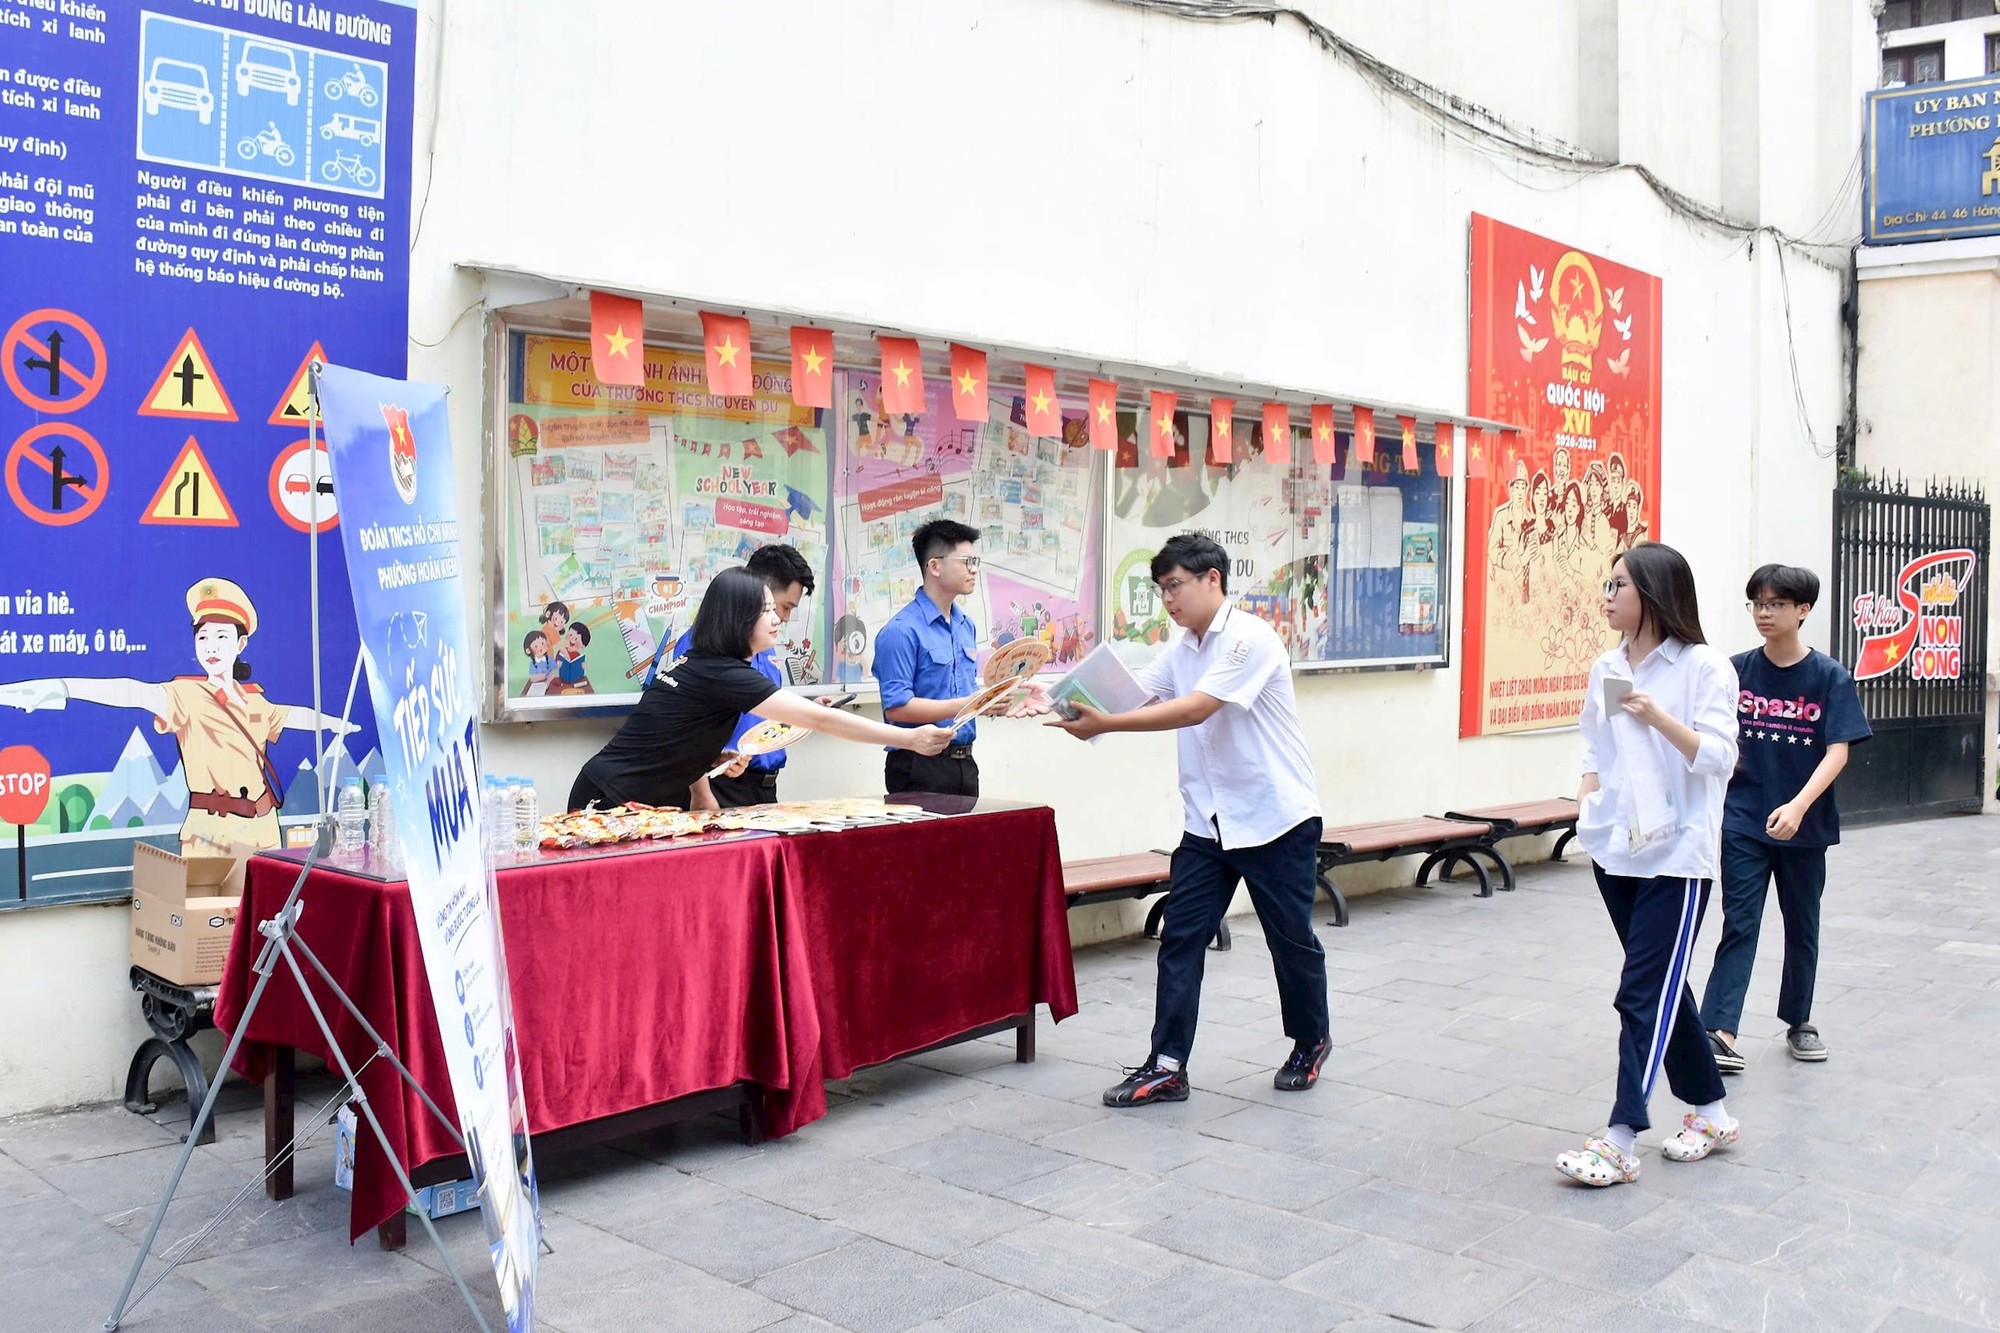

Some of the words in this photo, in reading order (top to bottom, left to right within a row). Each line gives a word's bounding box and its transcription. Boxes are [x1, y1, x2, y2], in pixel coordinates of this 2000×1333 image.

[42, 18, 58, 34] xi
[69, 21, 106, 44] lanh
[297, 2, 331, 32] LÀN
[335, 13, 392, 46] ĐƯỜNG
[14, 68, 60, 92] được
[63, 77, 101, 99] điều
[1, 89, 35, 109] tích
[42, 96, 58, 113] xi
[64, 98, 101, 121] lanh
[1946, 91, 1988, 111] BAN
[1909, 115, 1991, 138] PHƯỜNG
[22, 136, 67, 161] định)
[0, 171, 28, 191] hải
[33, 176, 62, 198] đội
[67, 183, 95, 200] mũ
[137, 170, 187, 190] Người
[196, 179, 232, 198] điều
[242, 186, 284, 206] khiển
[293, 196, 348, 219] phương
[357, 205, 385, 222] tiện
[44, 200, 94, 225] thông
[137, 193, 171, 210] phải
[180, 199, 196, 214] đi
[206, 202, 234, 219] bên
[243, 209, 275, 226] phải
[283, 214, 316, 232] theo
[324, 221, 362, 238] chiều
[370, 227, 385, 242] đi
[1931, 209, 1947, 220] 44
[1952, 207, 1968, 219] 46
[21, 220, 59, 239] toàn
[63, 224, 94, 243] của
[136, 214, 165, 232] của
[169, 220, 208, 237] mình
[212, 225, 228, 240] đi
[232, 227, 271, 249] đúng
[275, 233, 297, 250] làn
[301, 237, 347, 260] đường
[350, 245, 384, 262] phần
[135, 236, 188, 259] đường
[191, 246, 219, 263] quy
[222, 247, 256, 265] định
[259, 253, 277, 268] và
[279, 256, 310, 272] phải
[313, 260, 348, 280] chấp
[350, 264, 384, 282] hành
[135, 257, 156, 277] hệ
[158, 261, 204, 283] thống
[207, 266, 235, 283] báo
[238, 270, 270, 290] hiệu
[272, 275, 320, 297] đường
[323, 281, 345, 300] bộ.
[550, 350, 591, 375] MỘT
[667, 359, 702, 383] ẢNH
[752, 372, 792, 393] ĐỘNG
[571, 379, 601, 398] CỦA
[606, 384, 664, 403] TRƯỜNG
[668, 391, 702, 407] THCS
[761, 401, 778, 413] DU
[1546, 381, 1581, 409] QUỐC
[1583, 388, 1605, 417] HỘI
[1563, 407, 1591, 436] XVI
[1555, 433, 1597, 451] 2026-2031
[696, 477, 742, 494] SCHOOL
[743, 480, 777, 495] YEAR
[722, 465, 751, 480] NEW
[360, 521, 389, 551] ĐOÀN
[388, 525, 413, 548] TNCS
[412, 514, 426, 545] HỒ
[426, 516, 442, 544] CHÍ
[1224, 530, 1249, 545] THCS
[377, 559, 417, 590] PHƯỜNG
[417, 555, 441, 583] HOÀN
[1236, 558, 1254, 577] DU
[15, 588, 42, 615] vỉa
[47, 590, 75, 615] hè.
[648, 597, 688, 614] CHAMPION
[22, 633, 44, 653] xe
[49, 629, 90, 655] máy,
[94, 628, 105, 652] ô
[1922, 616, 1961, 646] NON
[1913, 645, 1960, 679] SÔNG
[393, 657, 430, 780] TIẾP
[431, 637, 462, 737] SỨC
